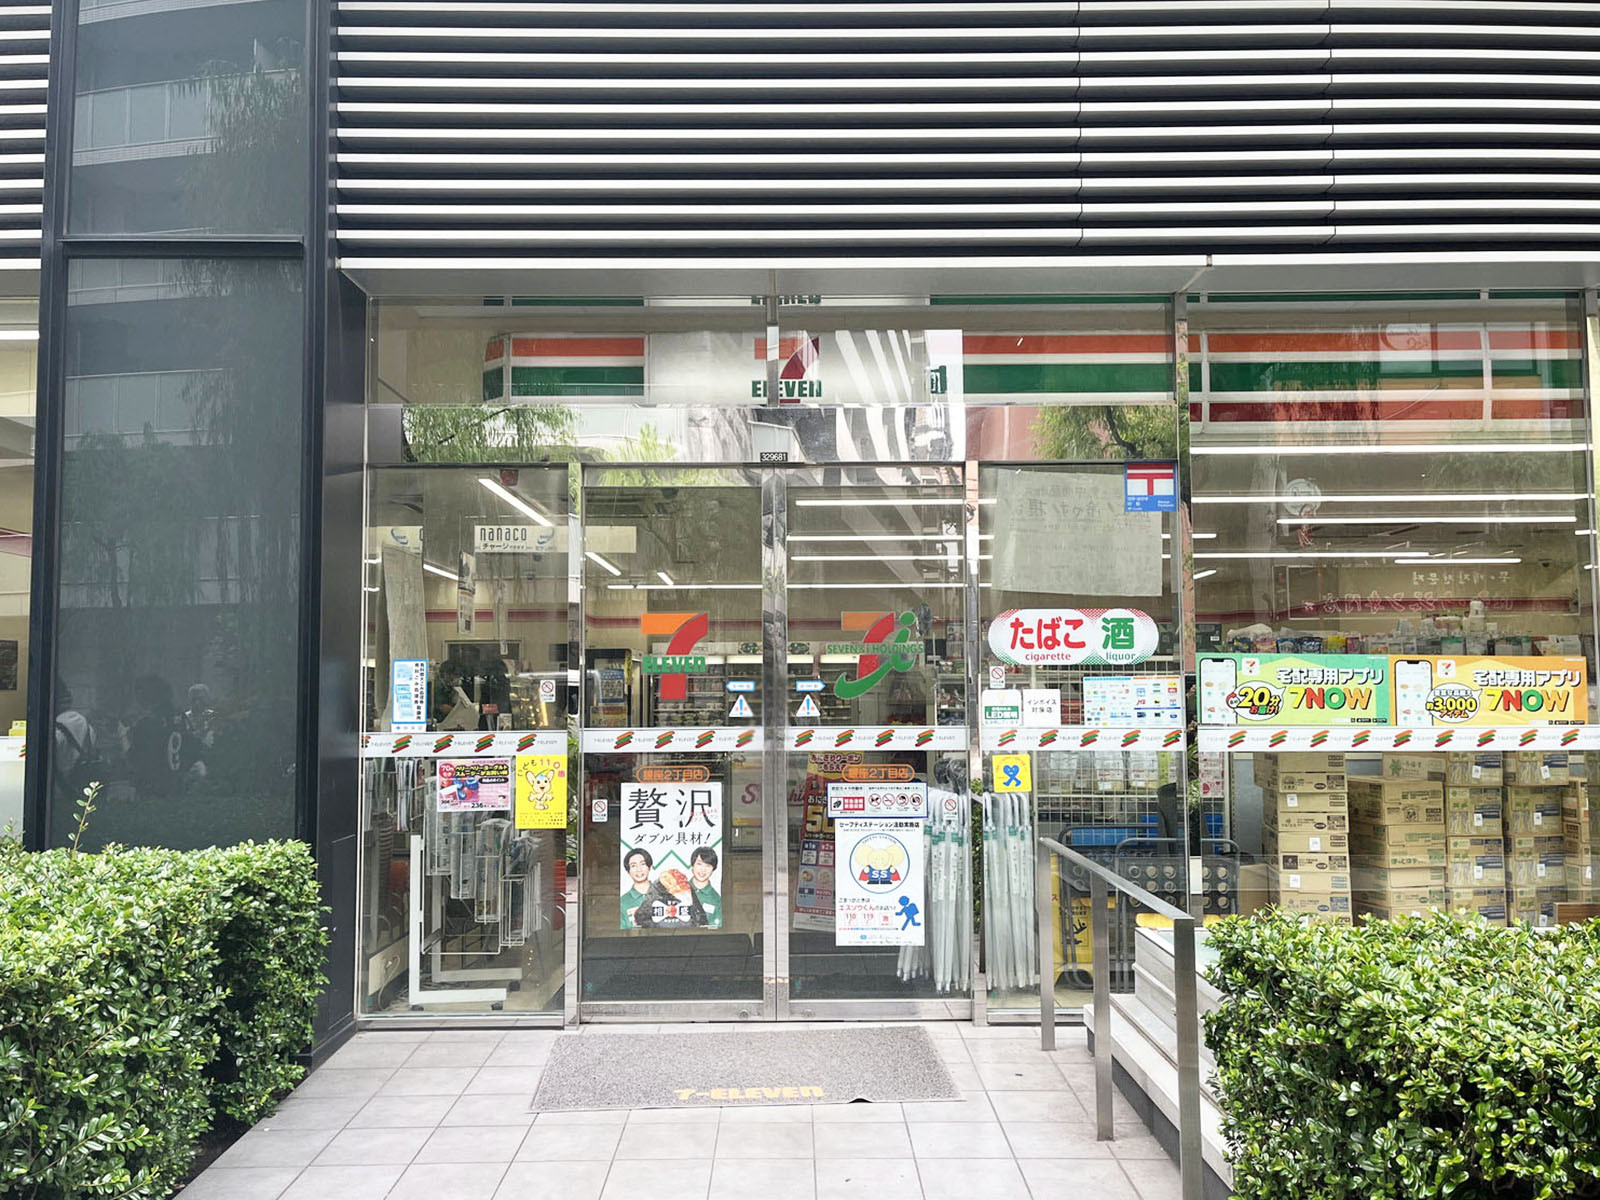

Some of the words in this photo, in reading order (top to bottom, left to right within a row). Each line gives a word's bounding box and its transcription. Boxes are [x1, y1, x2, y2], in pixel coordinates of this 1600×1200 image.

[760, 452, 788, 462] 329681
[480, 527, 527, 541] nanaco
[1010, 616, 1086, 650] たばこ
[1101, 617, 1135, 650] 酒
[1025, 652, 1072, 661] cigarette
[1105, 651, 1137, 662] liquor
[1277, 668, 1384, 685] 宅配専用アプリ
[1473, 670, 1581, 687] 宅配専用アプリ
[1238, 686, 1281, 708] 20分
[1288, 687, 1372, 710] 7NOW
[1486, 689, 1570, 712] 7NOW
[1440, 709, 1469, 718] アイテム
[628, 788, 716, 830] 贅沢
[634, 832, 711, 845] ダブル具材!
[871, 870, 888, 879] SS
